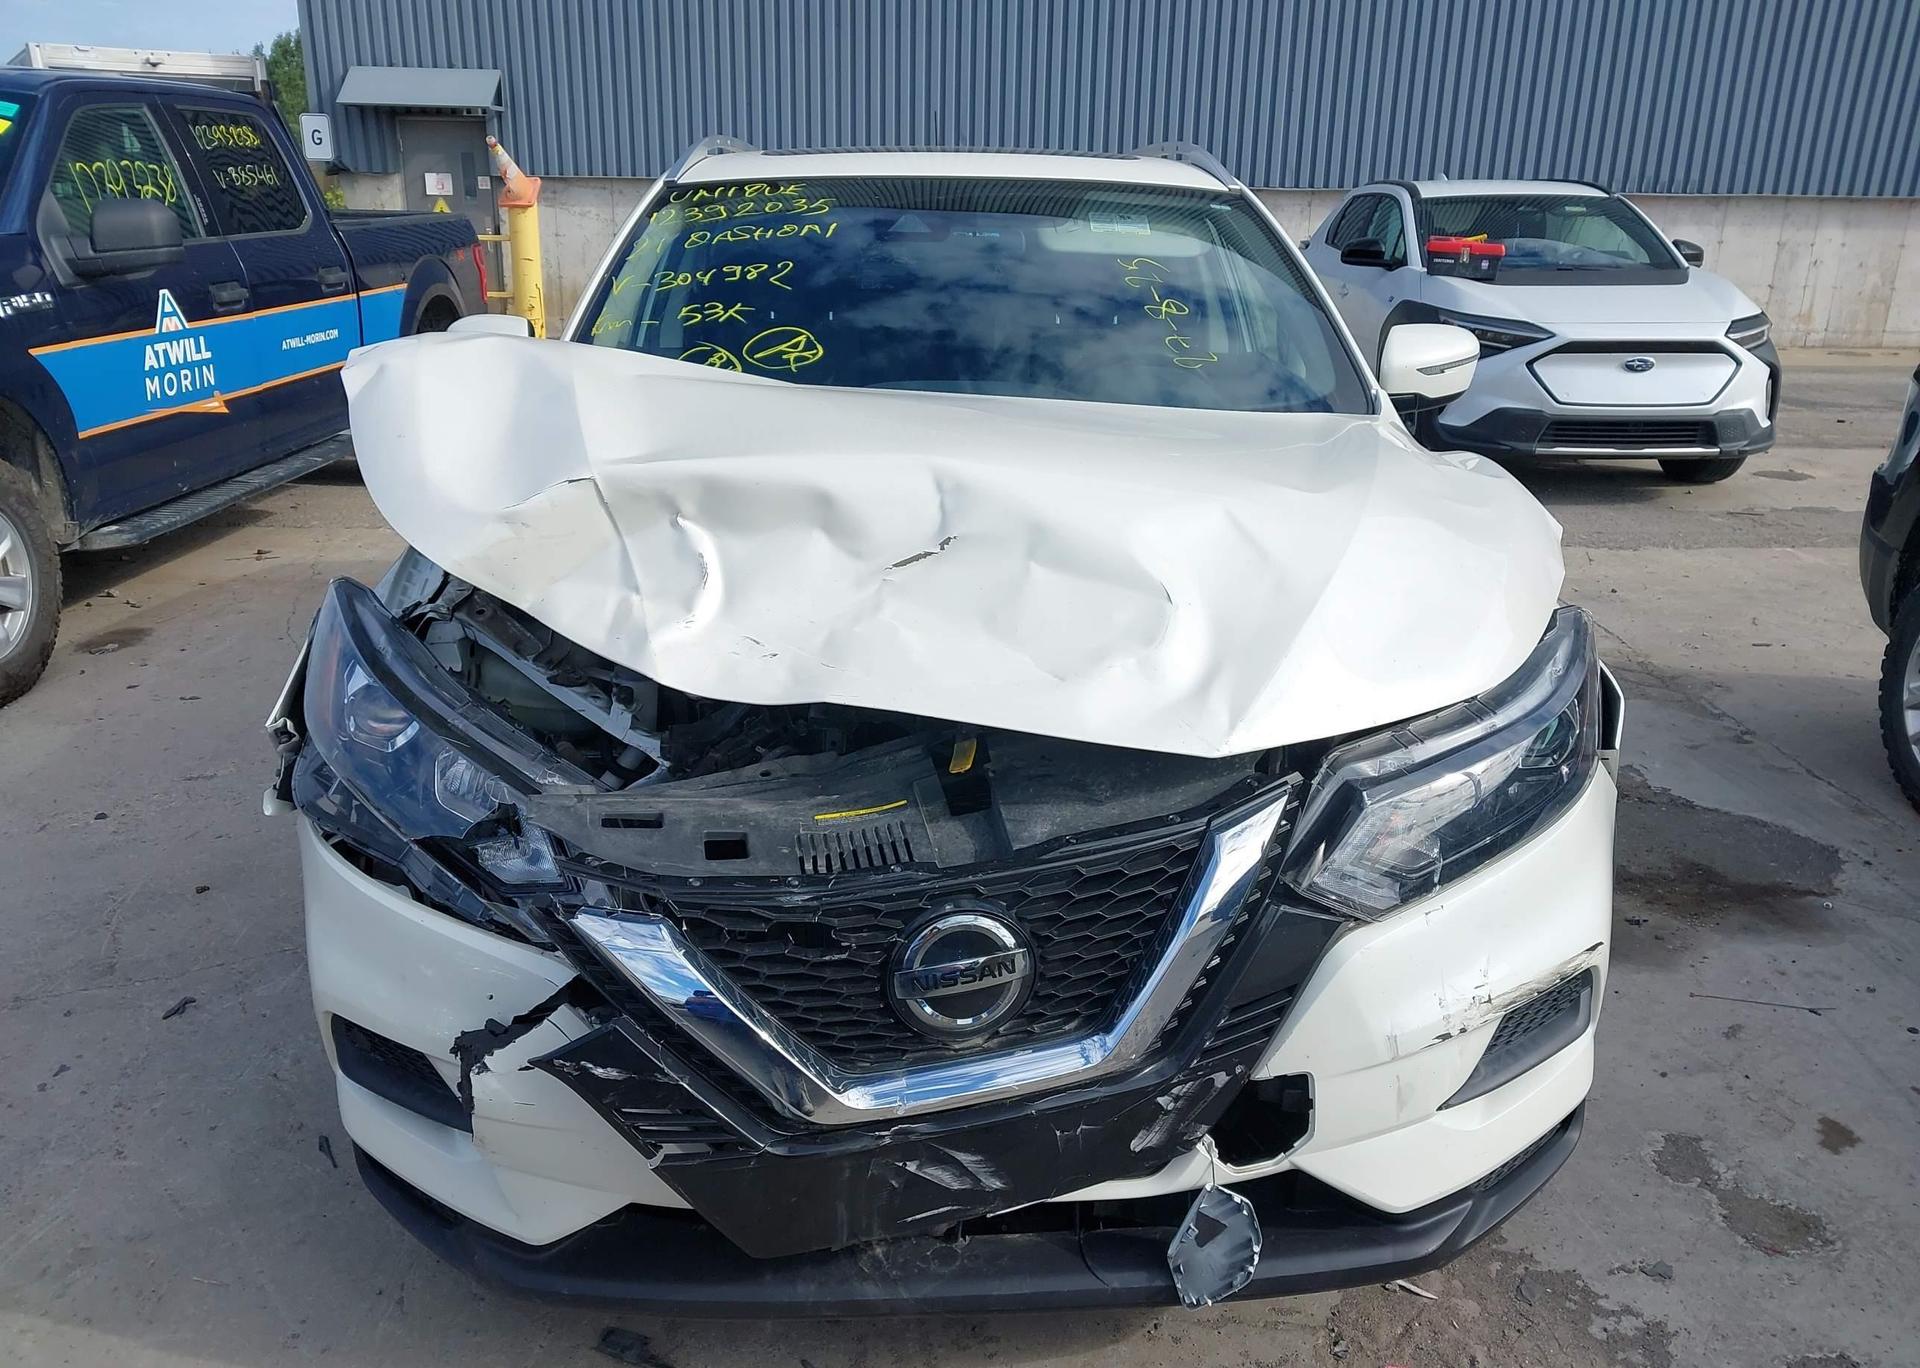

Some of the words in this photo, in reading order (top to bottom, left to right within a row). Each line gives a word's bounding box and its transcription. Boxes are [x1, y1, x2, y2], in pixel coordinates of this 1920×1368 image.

[311, 129, 323, 145] G
[144, 335, 212, 371] ATWILL
[281, 328, 339, 351] ATWILL-MORIN.COM
[145, 364, 215, 401] MORIN
[913, 958, 1017, 993] NISSAN
